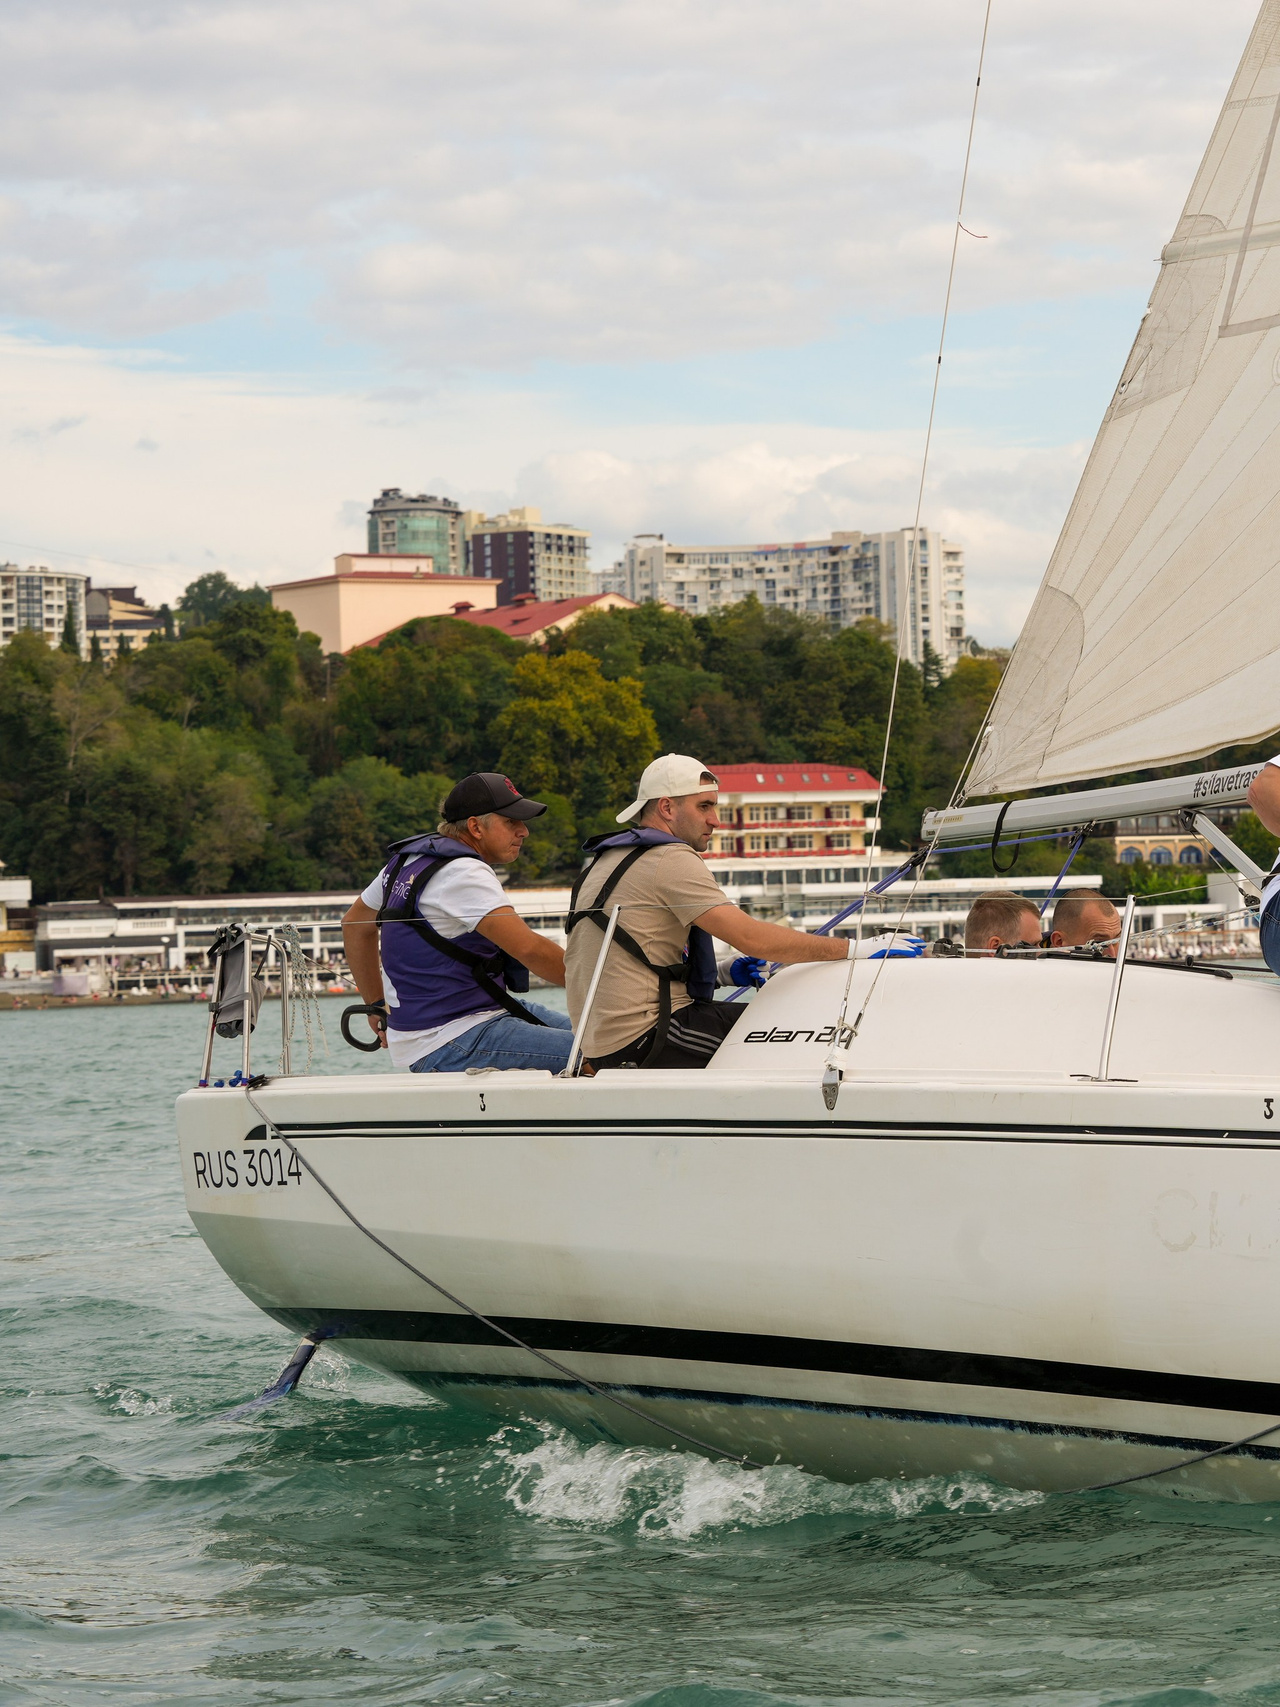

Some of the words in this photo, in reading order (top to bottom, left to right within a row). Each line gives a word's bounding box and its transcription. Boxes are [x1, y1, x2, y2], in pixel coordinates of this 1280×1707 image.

[1193, 768, 1264, 799] #silavetras
[743, 1026, 815, 1043] elan
[193, 1149, 239, 1189] RUS
[242, 1147, 303, 1188] 3014
